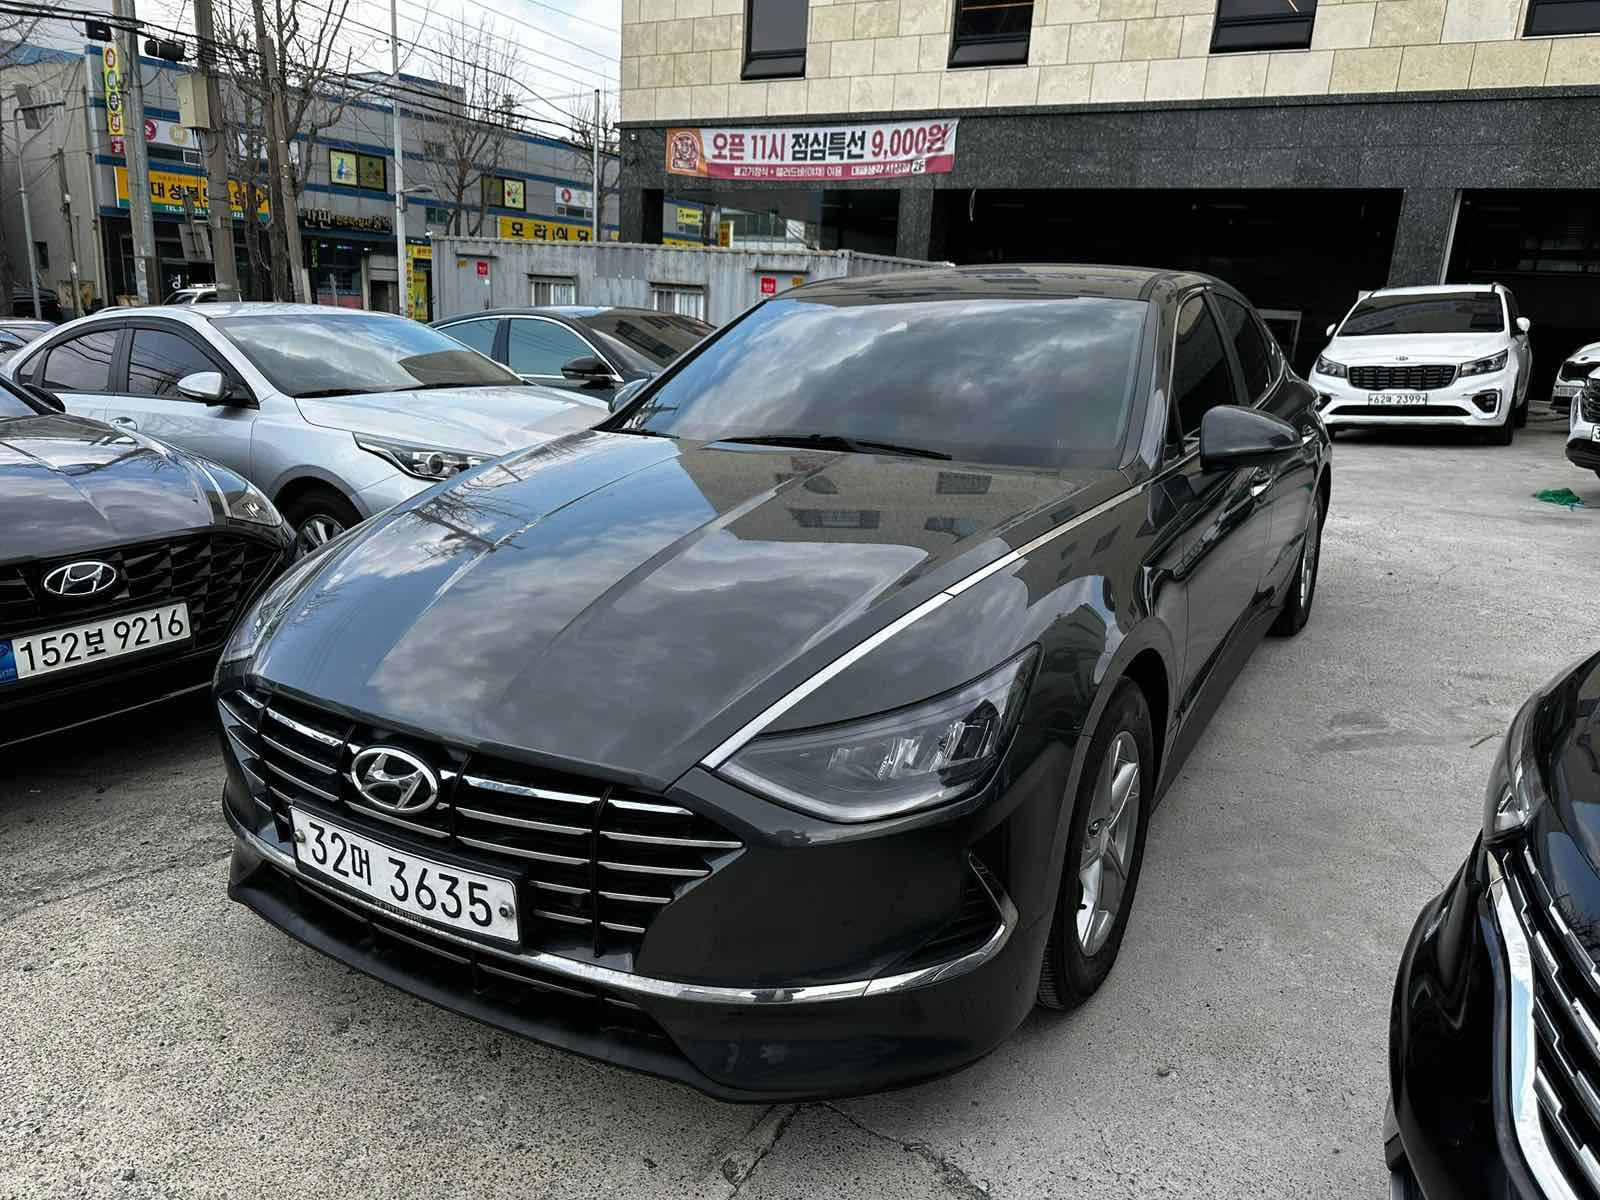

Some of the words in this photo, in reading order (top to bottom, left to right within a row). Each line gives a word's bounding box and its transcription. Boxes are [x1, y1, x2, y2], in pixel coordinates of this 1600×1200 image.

[711, 132, 745, 161] 오픈
[751, 133, 786, 161] 11시
[791, 129, 866, 161] 점심특선
[871, 123, 950, 159] 9,000원
[20, 628, 106, 671] 152보
[113, 609, 184, 649] 9216
[309, 822, 372, 886] 32머
[388, 857, 492, 927] 3635
